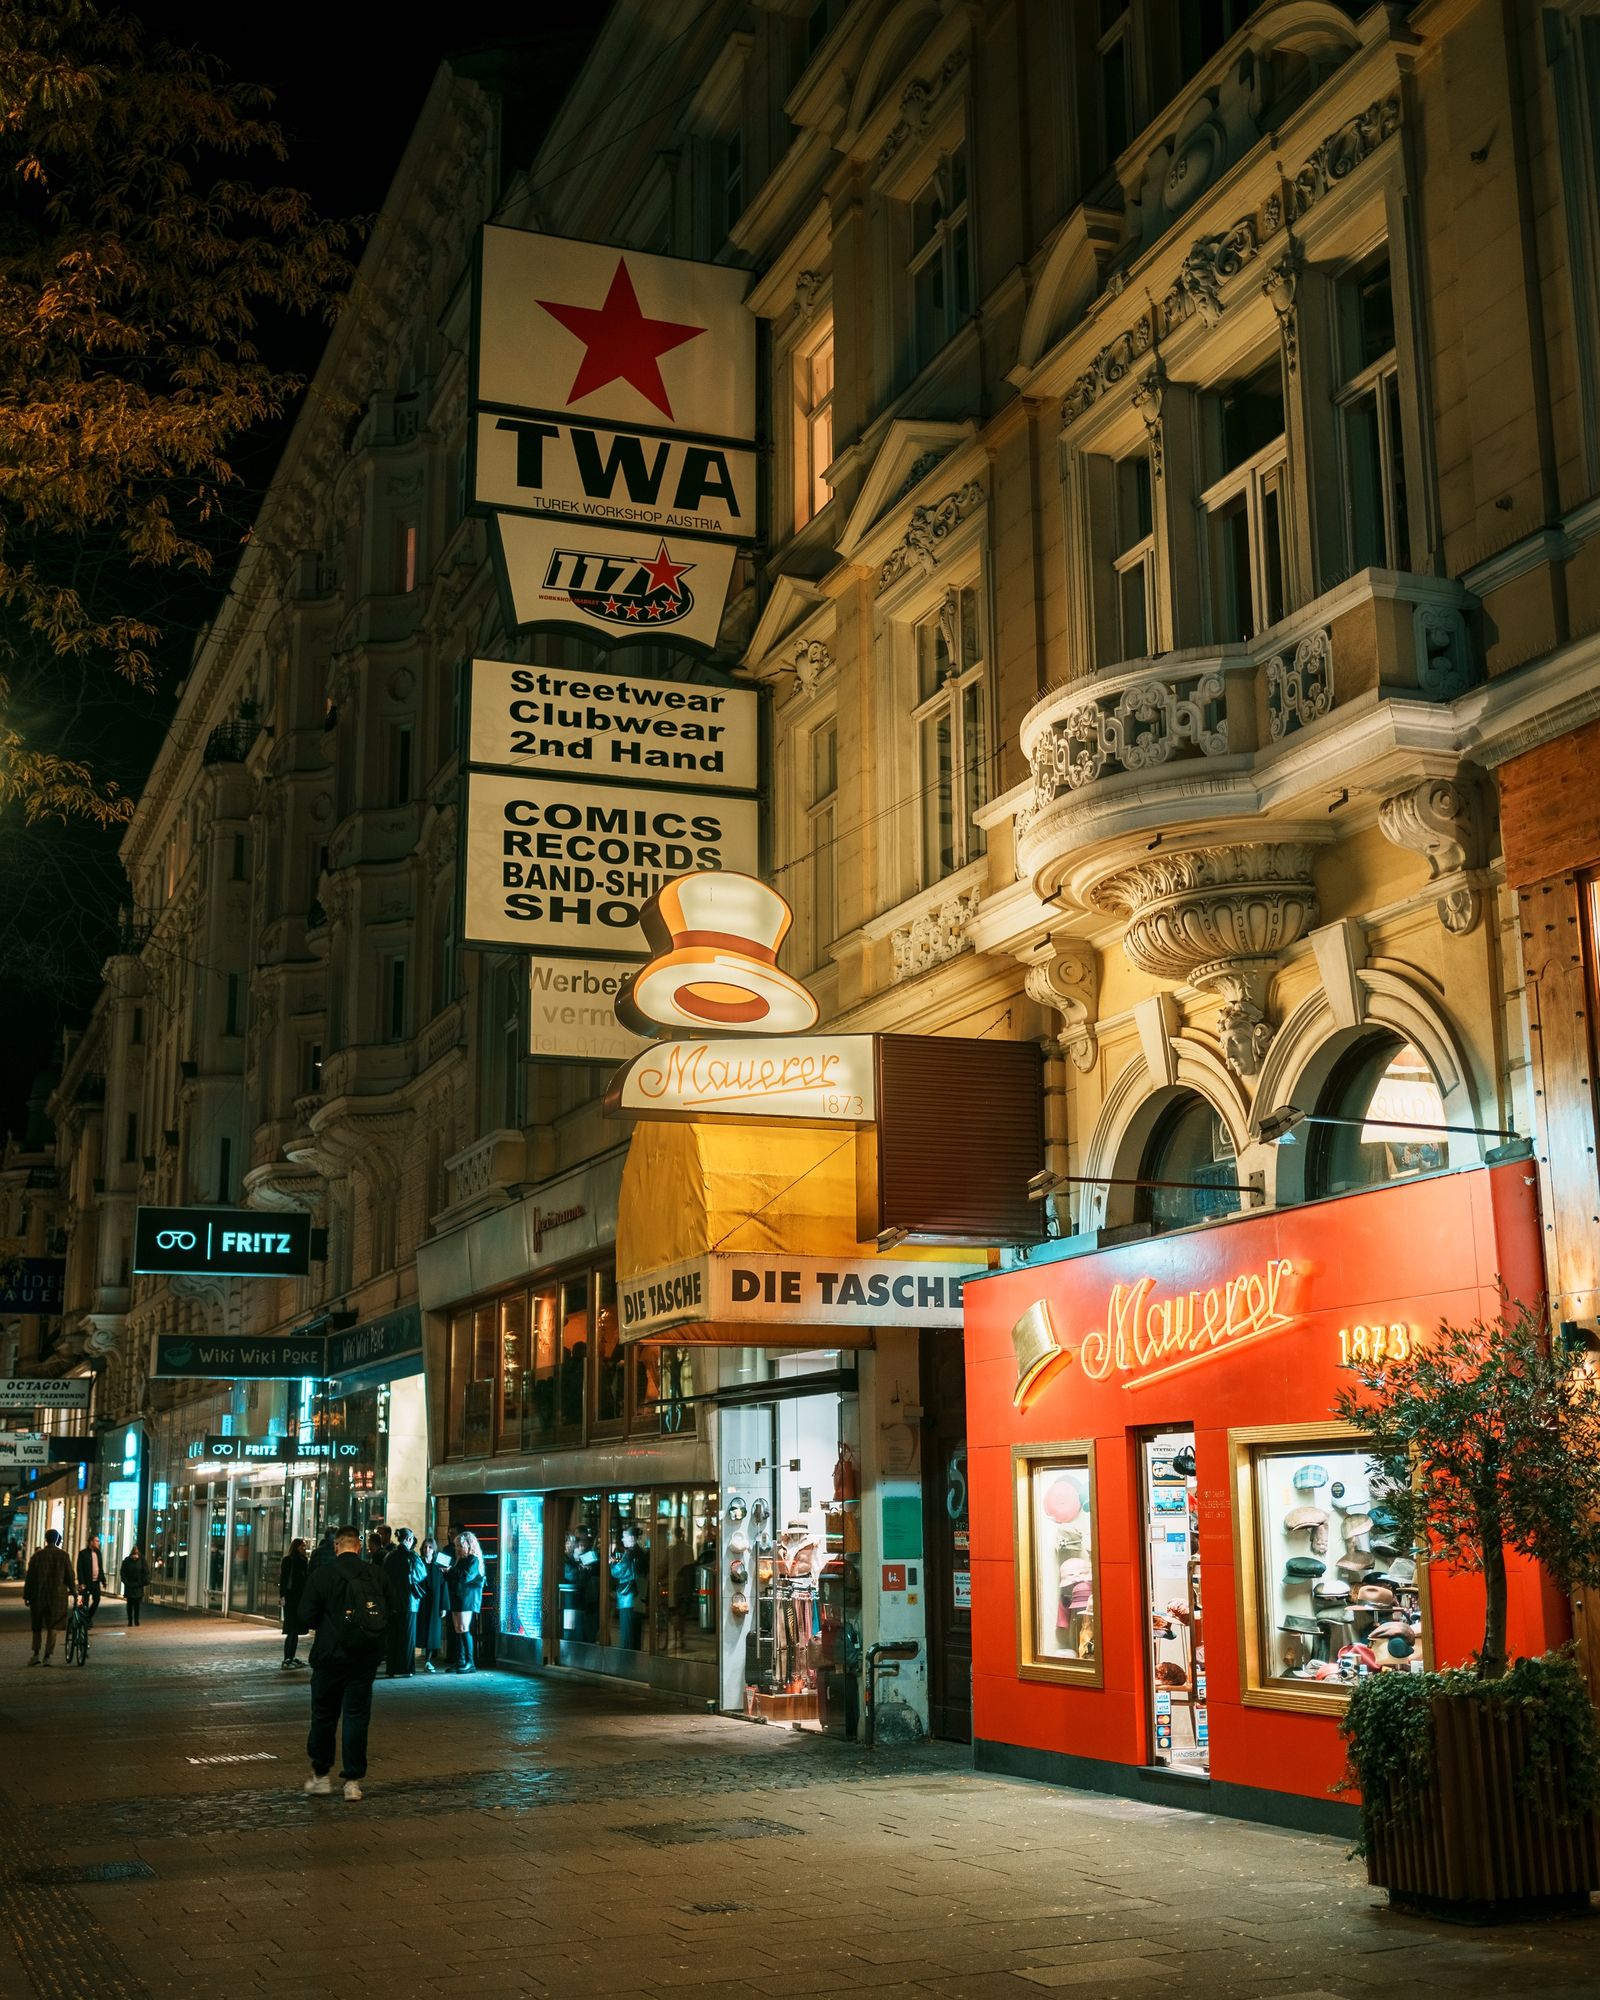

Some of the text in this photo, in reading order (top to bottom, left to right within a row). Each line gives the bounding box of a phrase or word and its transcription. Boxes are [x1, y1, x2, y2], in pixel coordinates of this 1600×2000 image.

[495, 418, 741, 518] TWA
[533, 496, 722, 531] TUREK WORKSHOP AUSTRIA
[552, 553, 642, 595] 117
[510, 670, 726, 714] Streetwear
[509, 699, 726, 743] Clubwear
[509, 730, 724, 773] 2nd Hand
[503, 799, 723, 842] COMICS
[503, 829, 723, 871] RECORDS
[530, 966, 635, 996] Werbef
[637, 1044, 840, 1100] Mauerer
[820, 1094, 865, 1117] 1873
[623, 1271, 701, 1325] DIE TASCHE
[731, 1269, 965, 1309] DIE TASCHE
[1080, 1258, 1296, 1380] Mauerer
[1338, 1322, 1410, 1365] 1873
[6, 1381, 71, 1391] OCTAGON
[22, 1445, 44, 1455] VANS
[727, 1458, 752, 1476] GUESS
